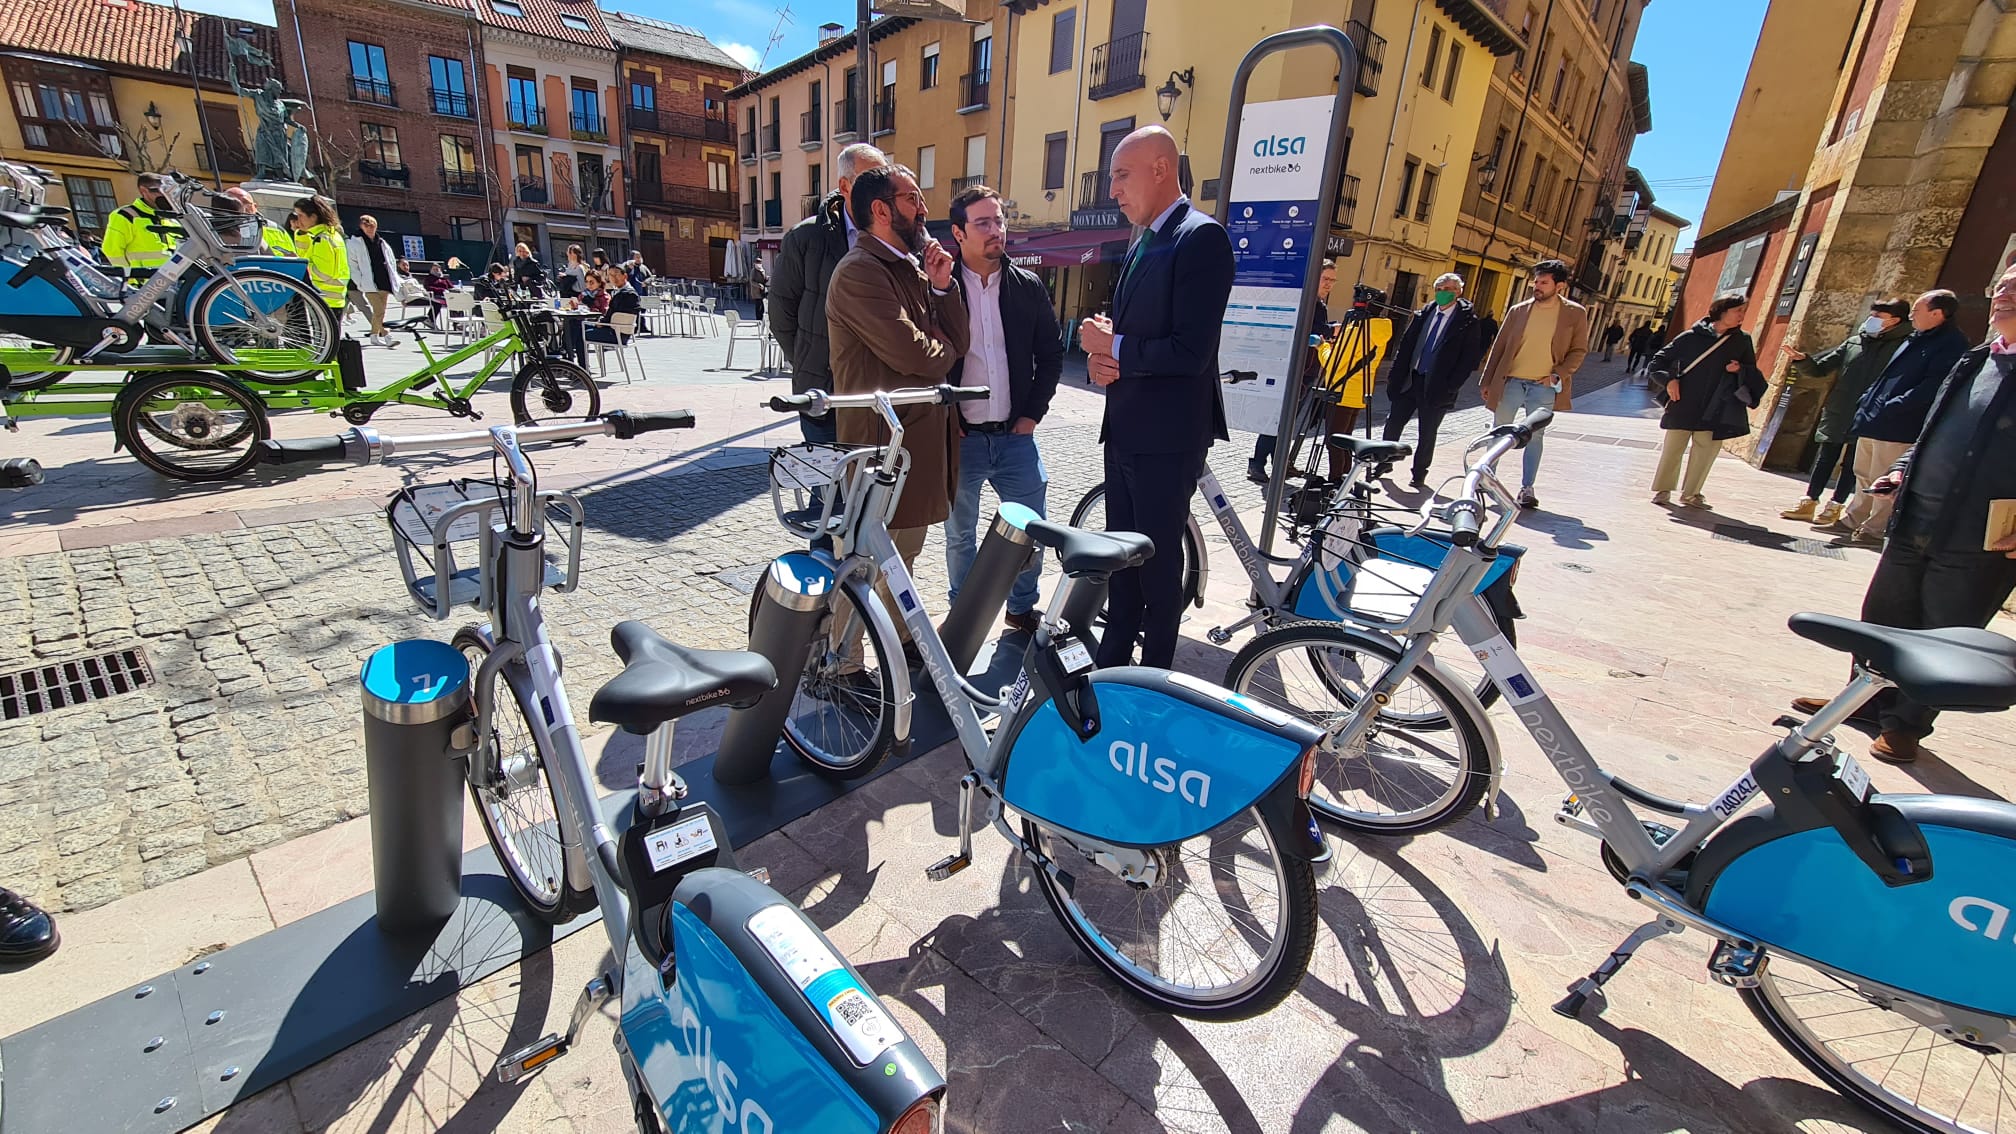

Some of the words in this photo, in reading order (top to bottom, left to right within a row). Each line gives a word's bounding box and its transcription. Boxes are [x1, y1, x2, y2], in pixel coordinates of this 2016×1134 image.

[1253, 134, 1306, 157] alsa
[1327, 237, 1345, 252] BAR
[126, 278, 167, 319] nextbike
[1220, 515, 1260, 580] nextbike
[911, 624, 965, 730] nextbike
[1108, 740, 1211, 809] alsa
[1520, 709, 1613, 825] nextbike
[1715, 777, 1758, 816] 240242
